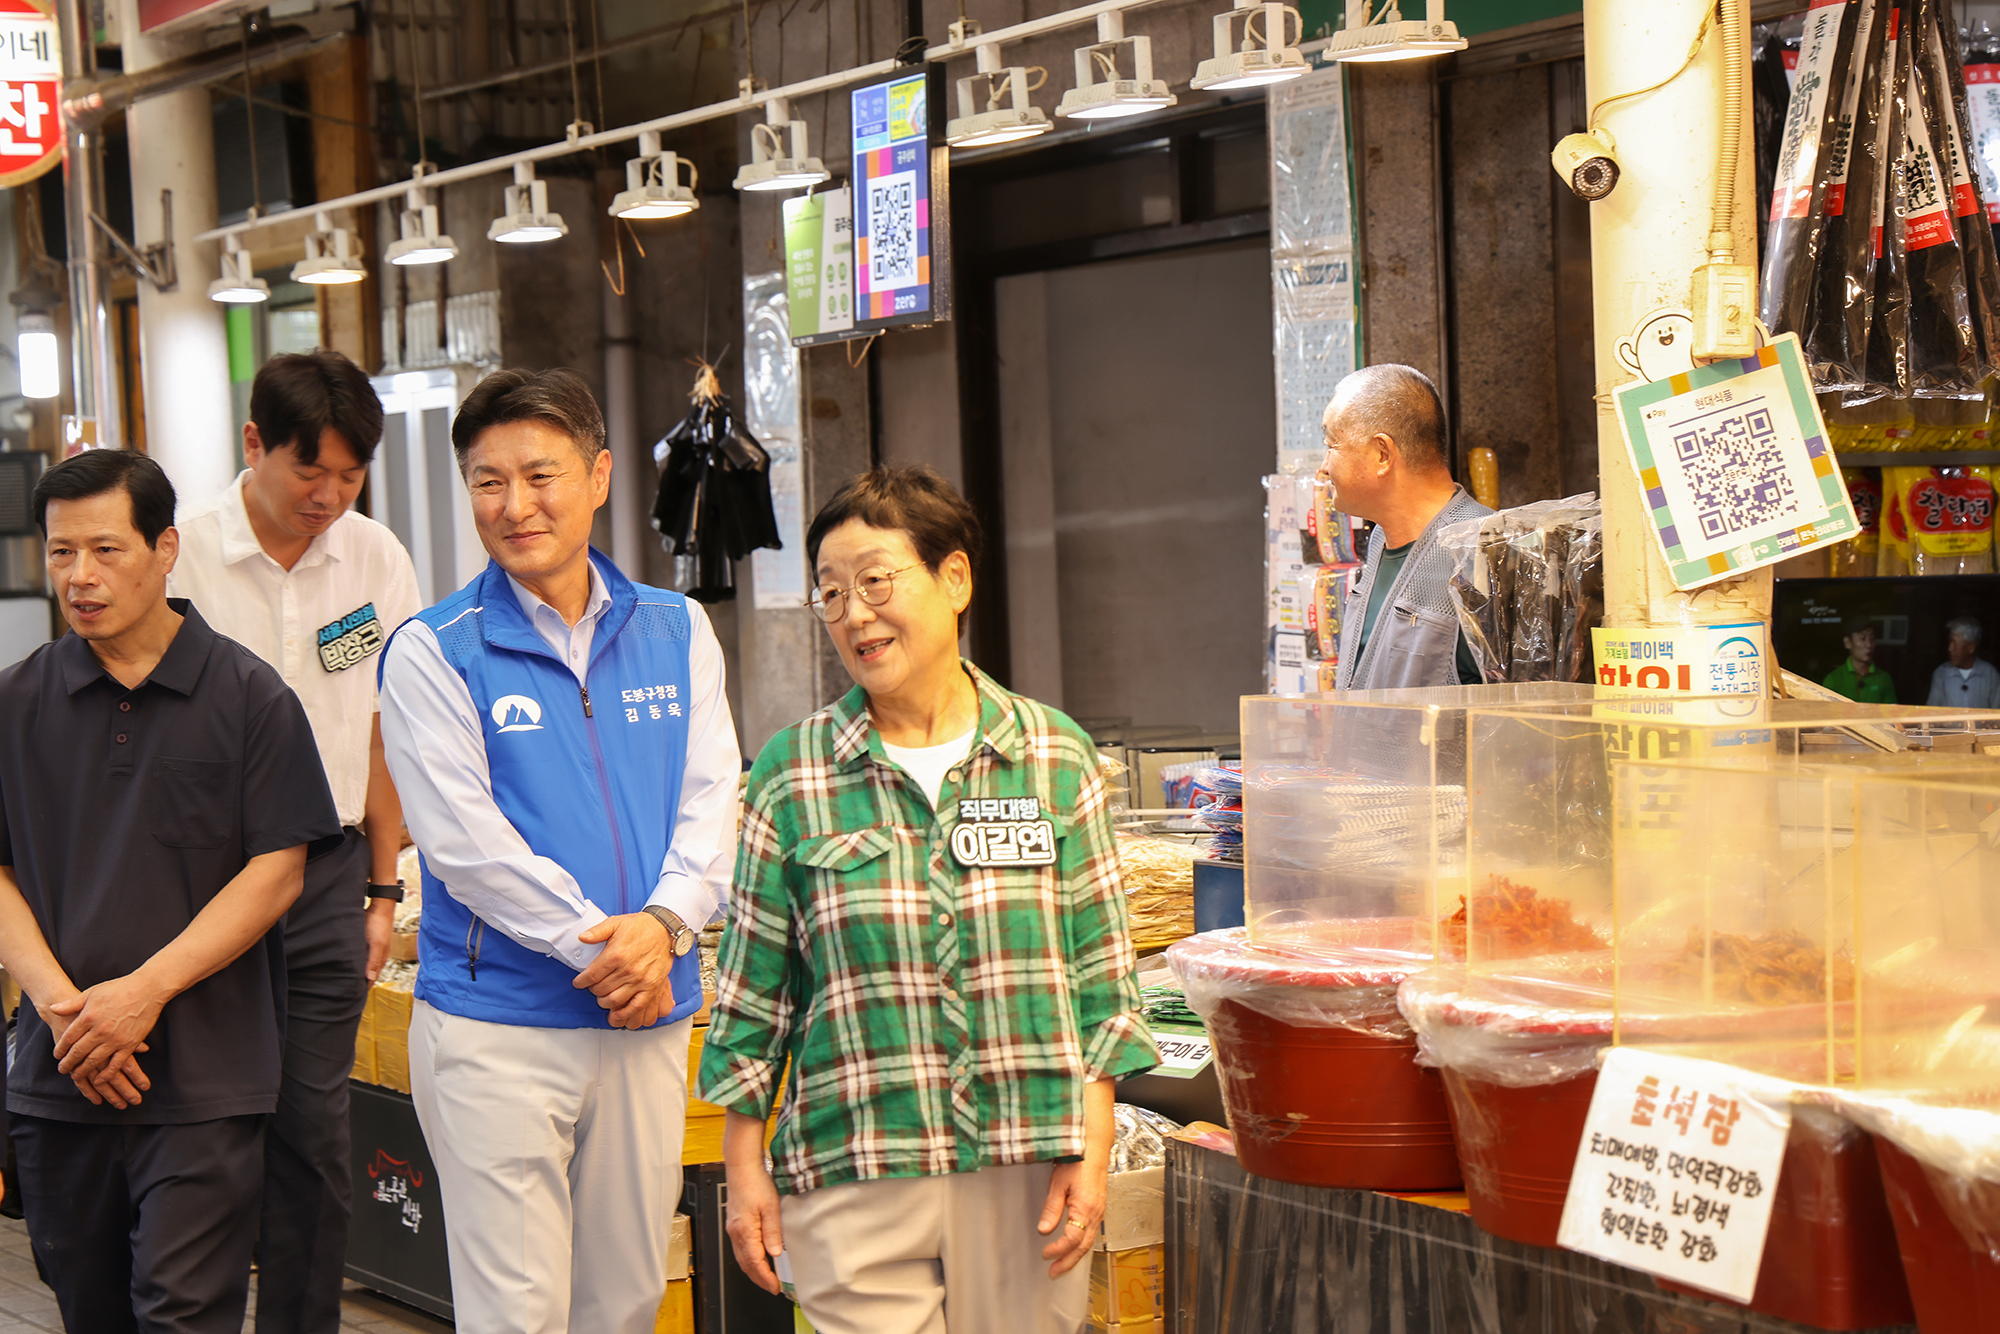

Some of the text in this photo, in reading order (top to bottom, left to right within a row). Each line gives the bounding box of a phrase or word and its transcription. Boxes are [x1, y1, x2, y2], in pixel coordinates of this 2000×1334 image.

[894, 295, 917, 311] zero
[1652, 408, 1667, 418] Pay
[1694, 389, 1733, 411] 현대식품
[1724, 467, 1748, 481] zero
[1917, 487, 1992, 529] 찰당면
[318, 603, 376, 645] 서울시의원
[323, 624, 384, 669] 박상근
[1630, 641, 1674, 660] 페이백
[1709, 660, 1761, 681] 전통시장
[621, 684, 678, 704] 도봉구청장
[958, 797, 1041, 822] 직무대행
[954, 822, 1055, 863] 이길연
[1629, 1074, 1742, 1147] 초석잠
[1590, 1132, 1764, 1199] 치매예방, 면역력강화
[1671, 1190, 1731, 1230] 뇌경색
[1601, 1207, 1720, 1263] 혈액순환 강화
